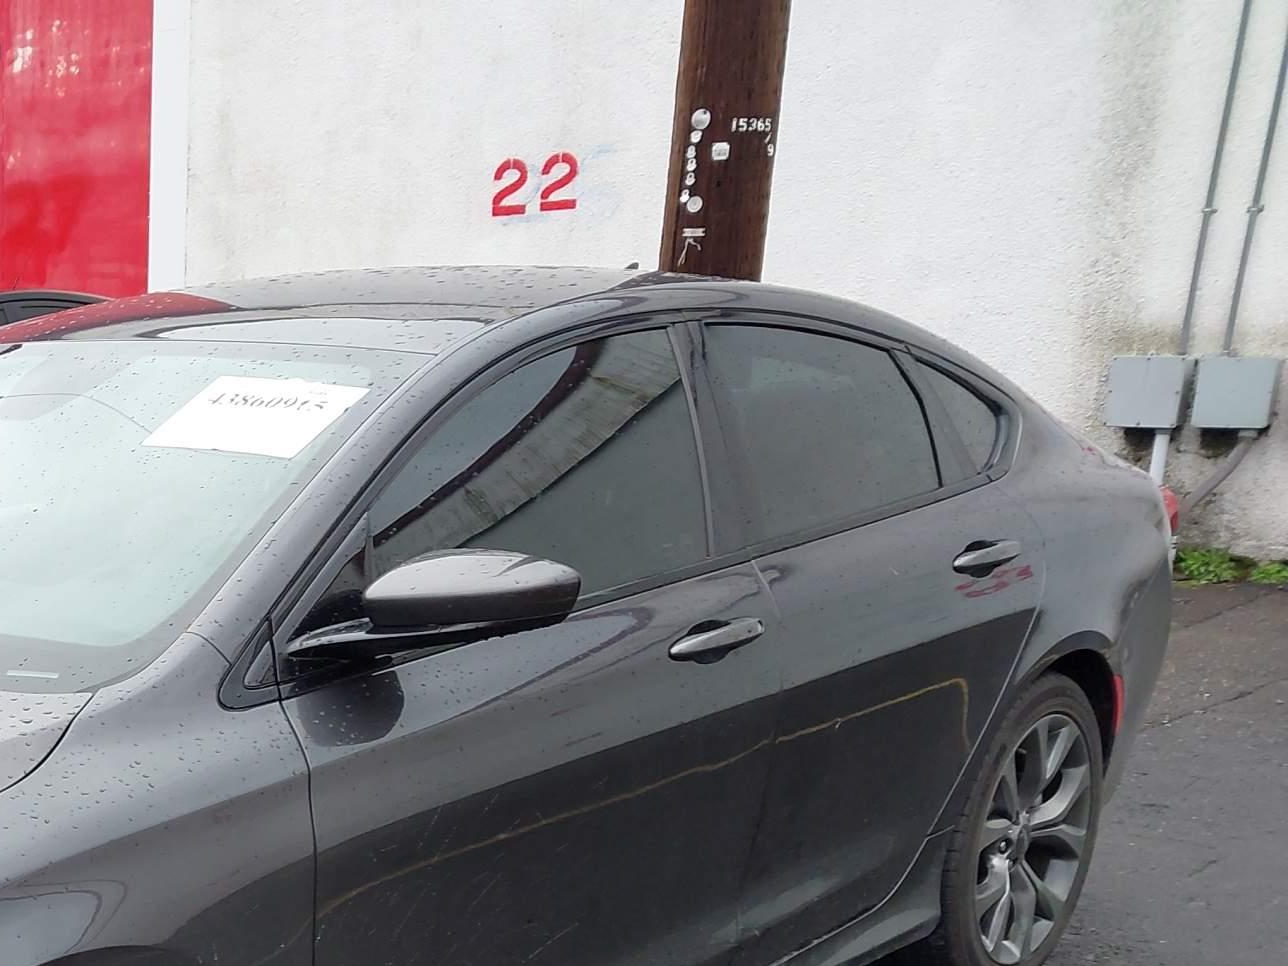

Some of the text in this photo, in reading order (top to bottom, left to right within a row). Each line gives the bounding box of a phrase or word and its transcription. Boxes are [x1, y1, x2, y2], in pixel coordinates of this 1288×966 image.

[731, 117, 773, 132] 15365
[767, 143, 775, 157] 9
[492, 152, 578, 217] 22
